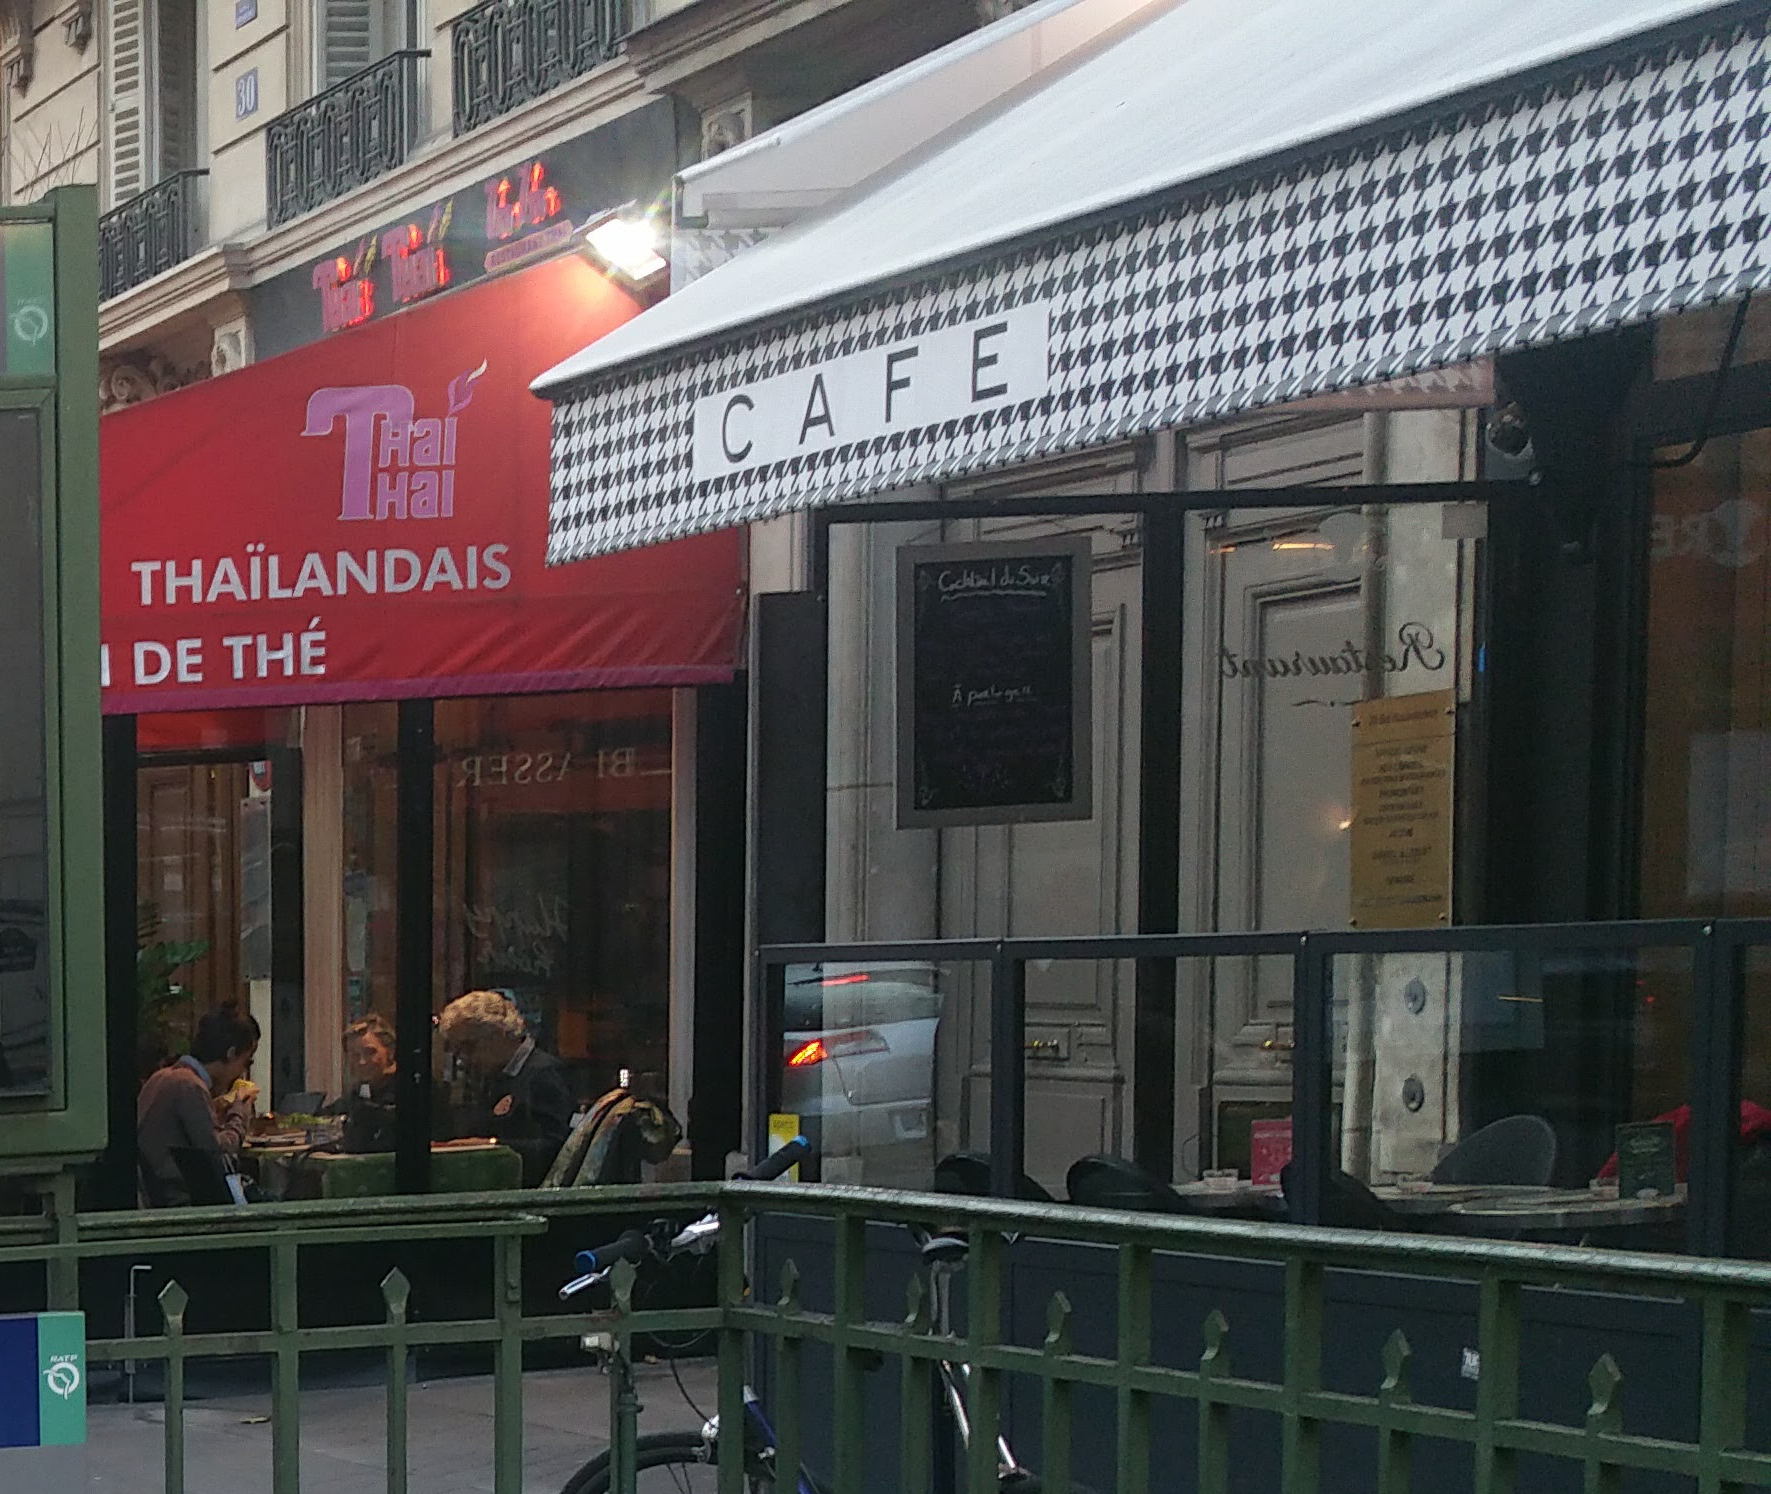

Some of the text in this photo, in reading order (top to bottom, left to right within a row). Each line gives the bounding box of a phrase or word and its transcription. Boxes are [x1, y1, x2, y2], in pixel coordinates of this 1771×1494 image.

[720, 321, 1009, 463] CAFE
[131, 543, 511, 605] THAÏLANDAIS
[134, 638, 203, 684] DE
[223, 616, 326, 679] THÉ
